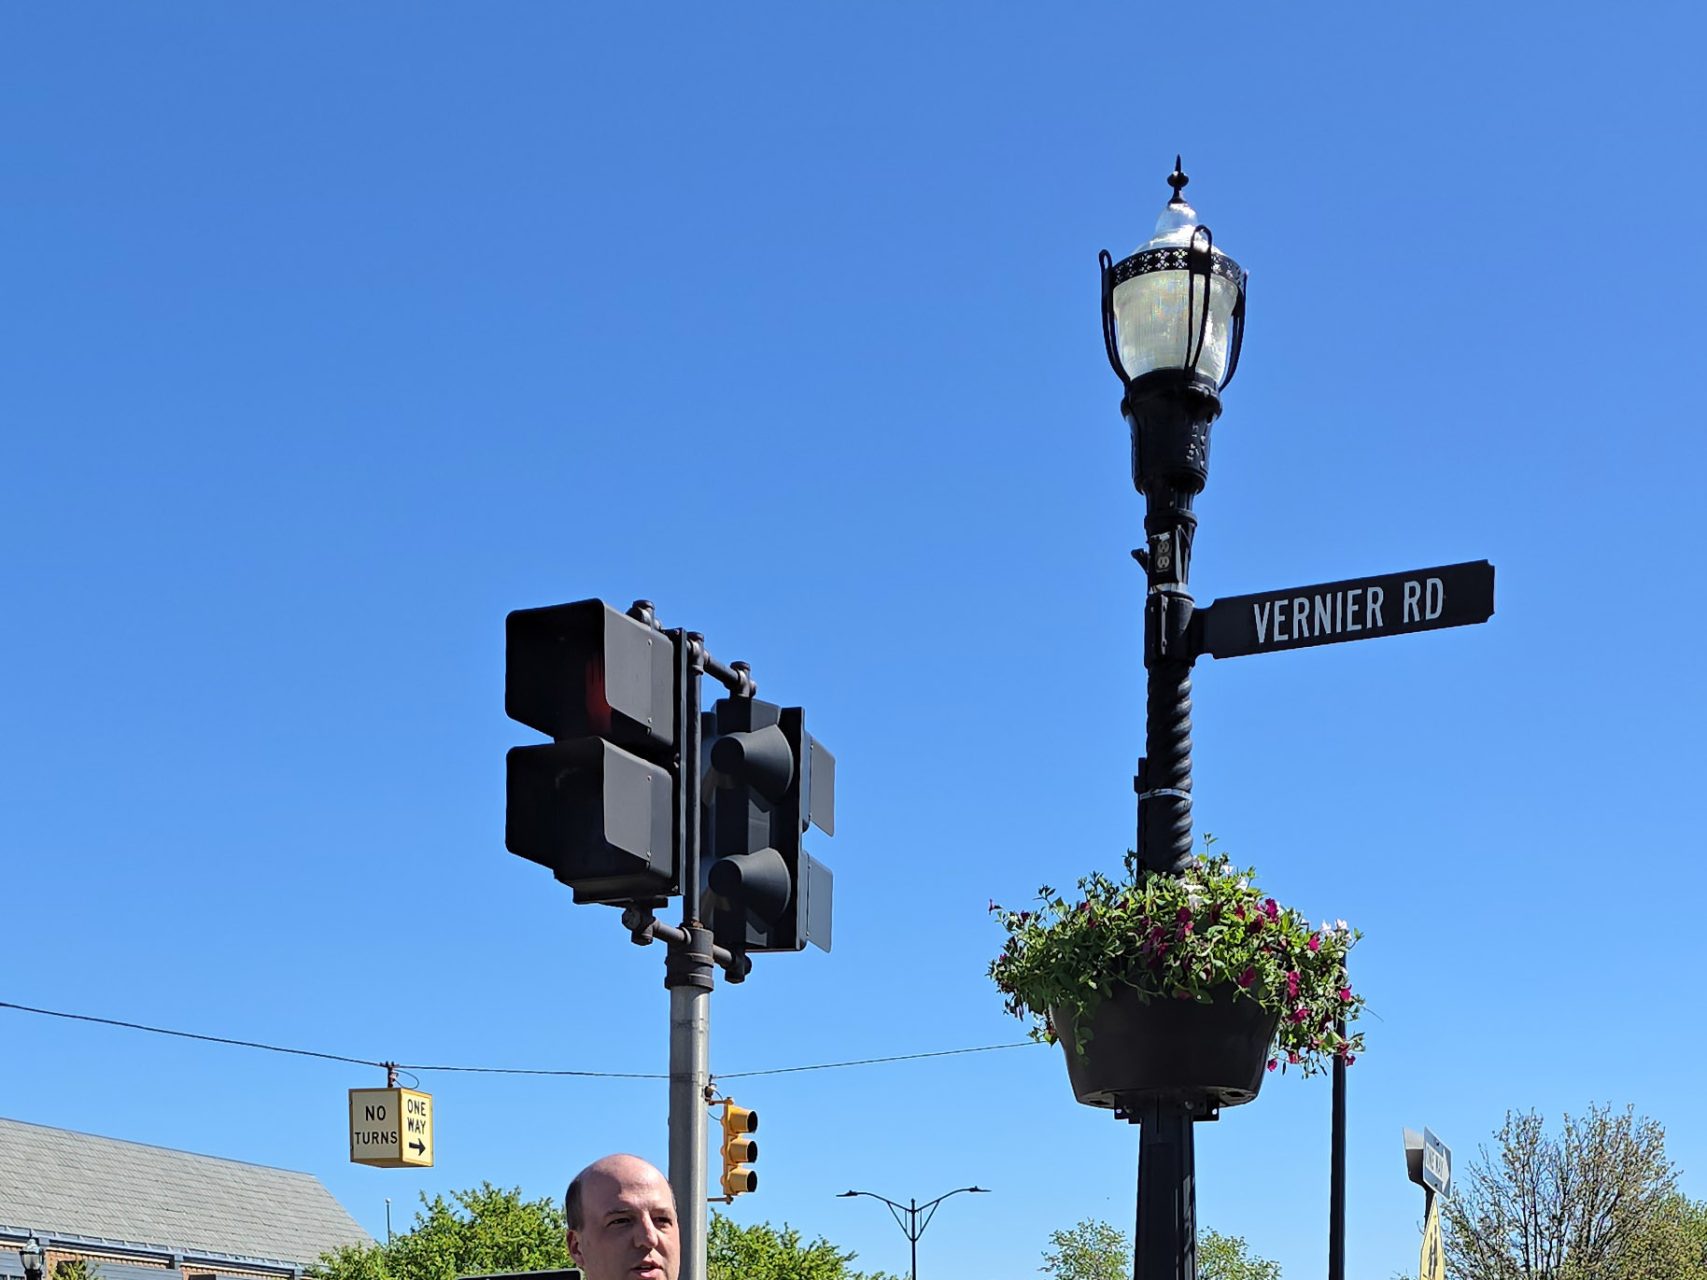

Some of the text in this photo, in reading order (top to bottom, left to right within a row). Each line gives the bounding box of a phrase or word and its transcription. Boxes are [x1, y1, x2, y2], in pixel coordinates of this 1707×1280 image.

[1253, 577, 1444, 644] VERNIER RD
[365, 1105, 387, 1121] NO
[407, 1098, 427, 1117] ONE
[407, 1117, 426, 1135] WAY
[354, 1131, 398, 1145] TURNS
